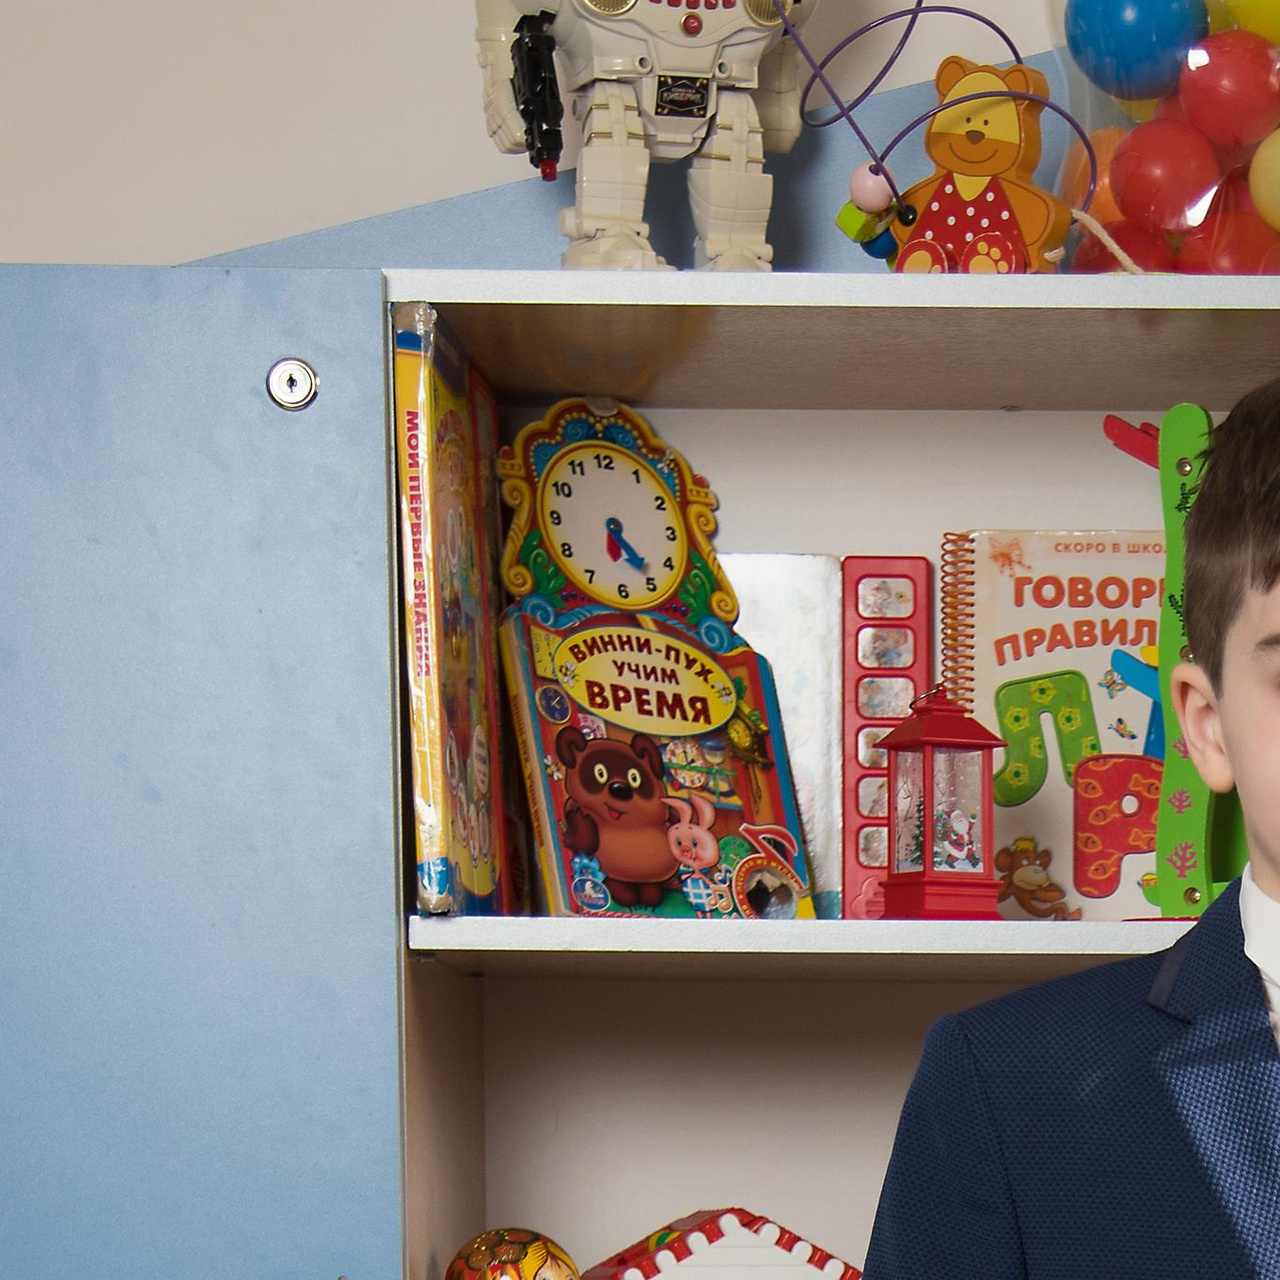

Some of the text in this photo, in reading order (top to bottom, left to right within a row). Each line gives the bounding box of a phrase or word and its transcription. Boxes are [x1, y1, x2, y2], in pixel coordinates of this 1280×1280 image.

[405, 410, 420, 469] МОИ
[568, 460, 585, 476] 11
[594, 454, 615, 470] 12
[632, 469, 641, 484] 1
[552, 481, 572, 497] 10
[654, 496, 667, 511] 2
[407, 474, 424, 574] ПЕРВЫЕ
[550, 510, 562, 525] 9
[665, 527, 677, 542] 3
[561, 543, 573, 558] 8
[1054, 542, 1167, 553] СКОРО В ШКО
[663, 557, 674, 571] 4
[584, 569, 595, 584] 7
[617, 584, 629, 599] 6
[646, 577, 657, 592] 5
[568, 634, 716, 690] ВИННИ-ПУХ.
[612, 660, 680, 685] УЧИМ
[585, 679, 712, 725] ВРЕМЯ
